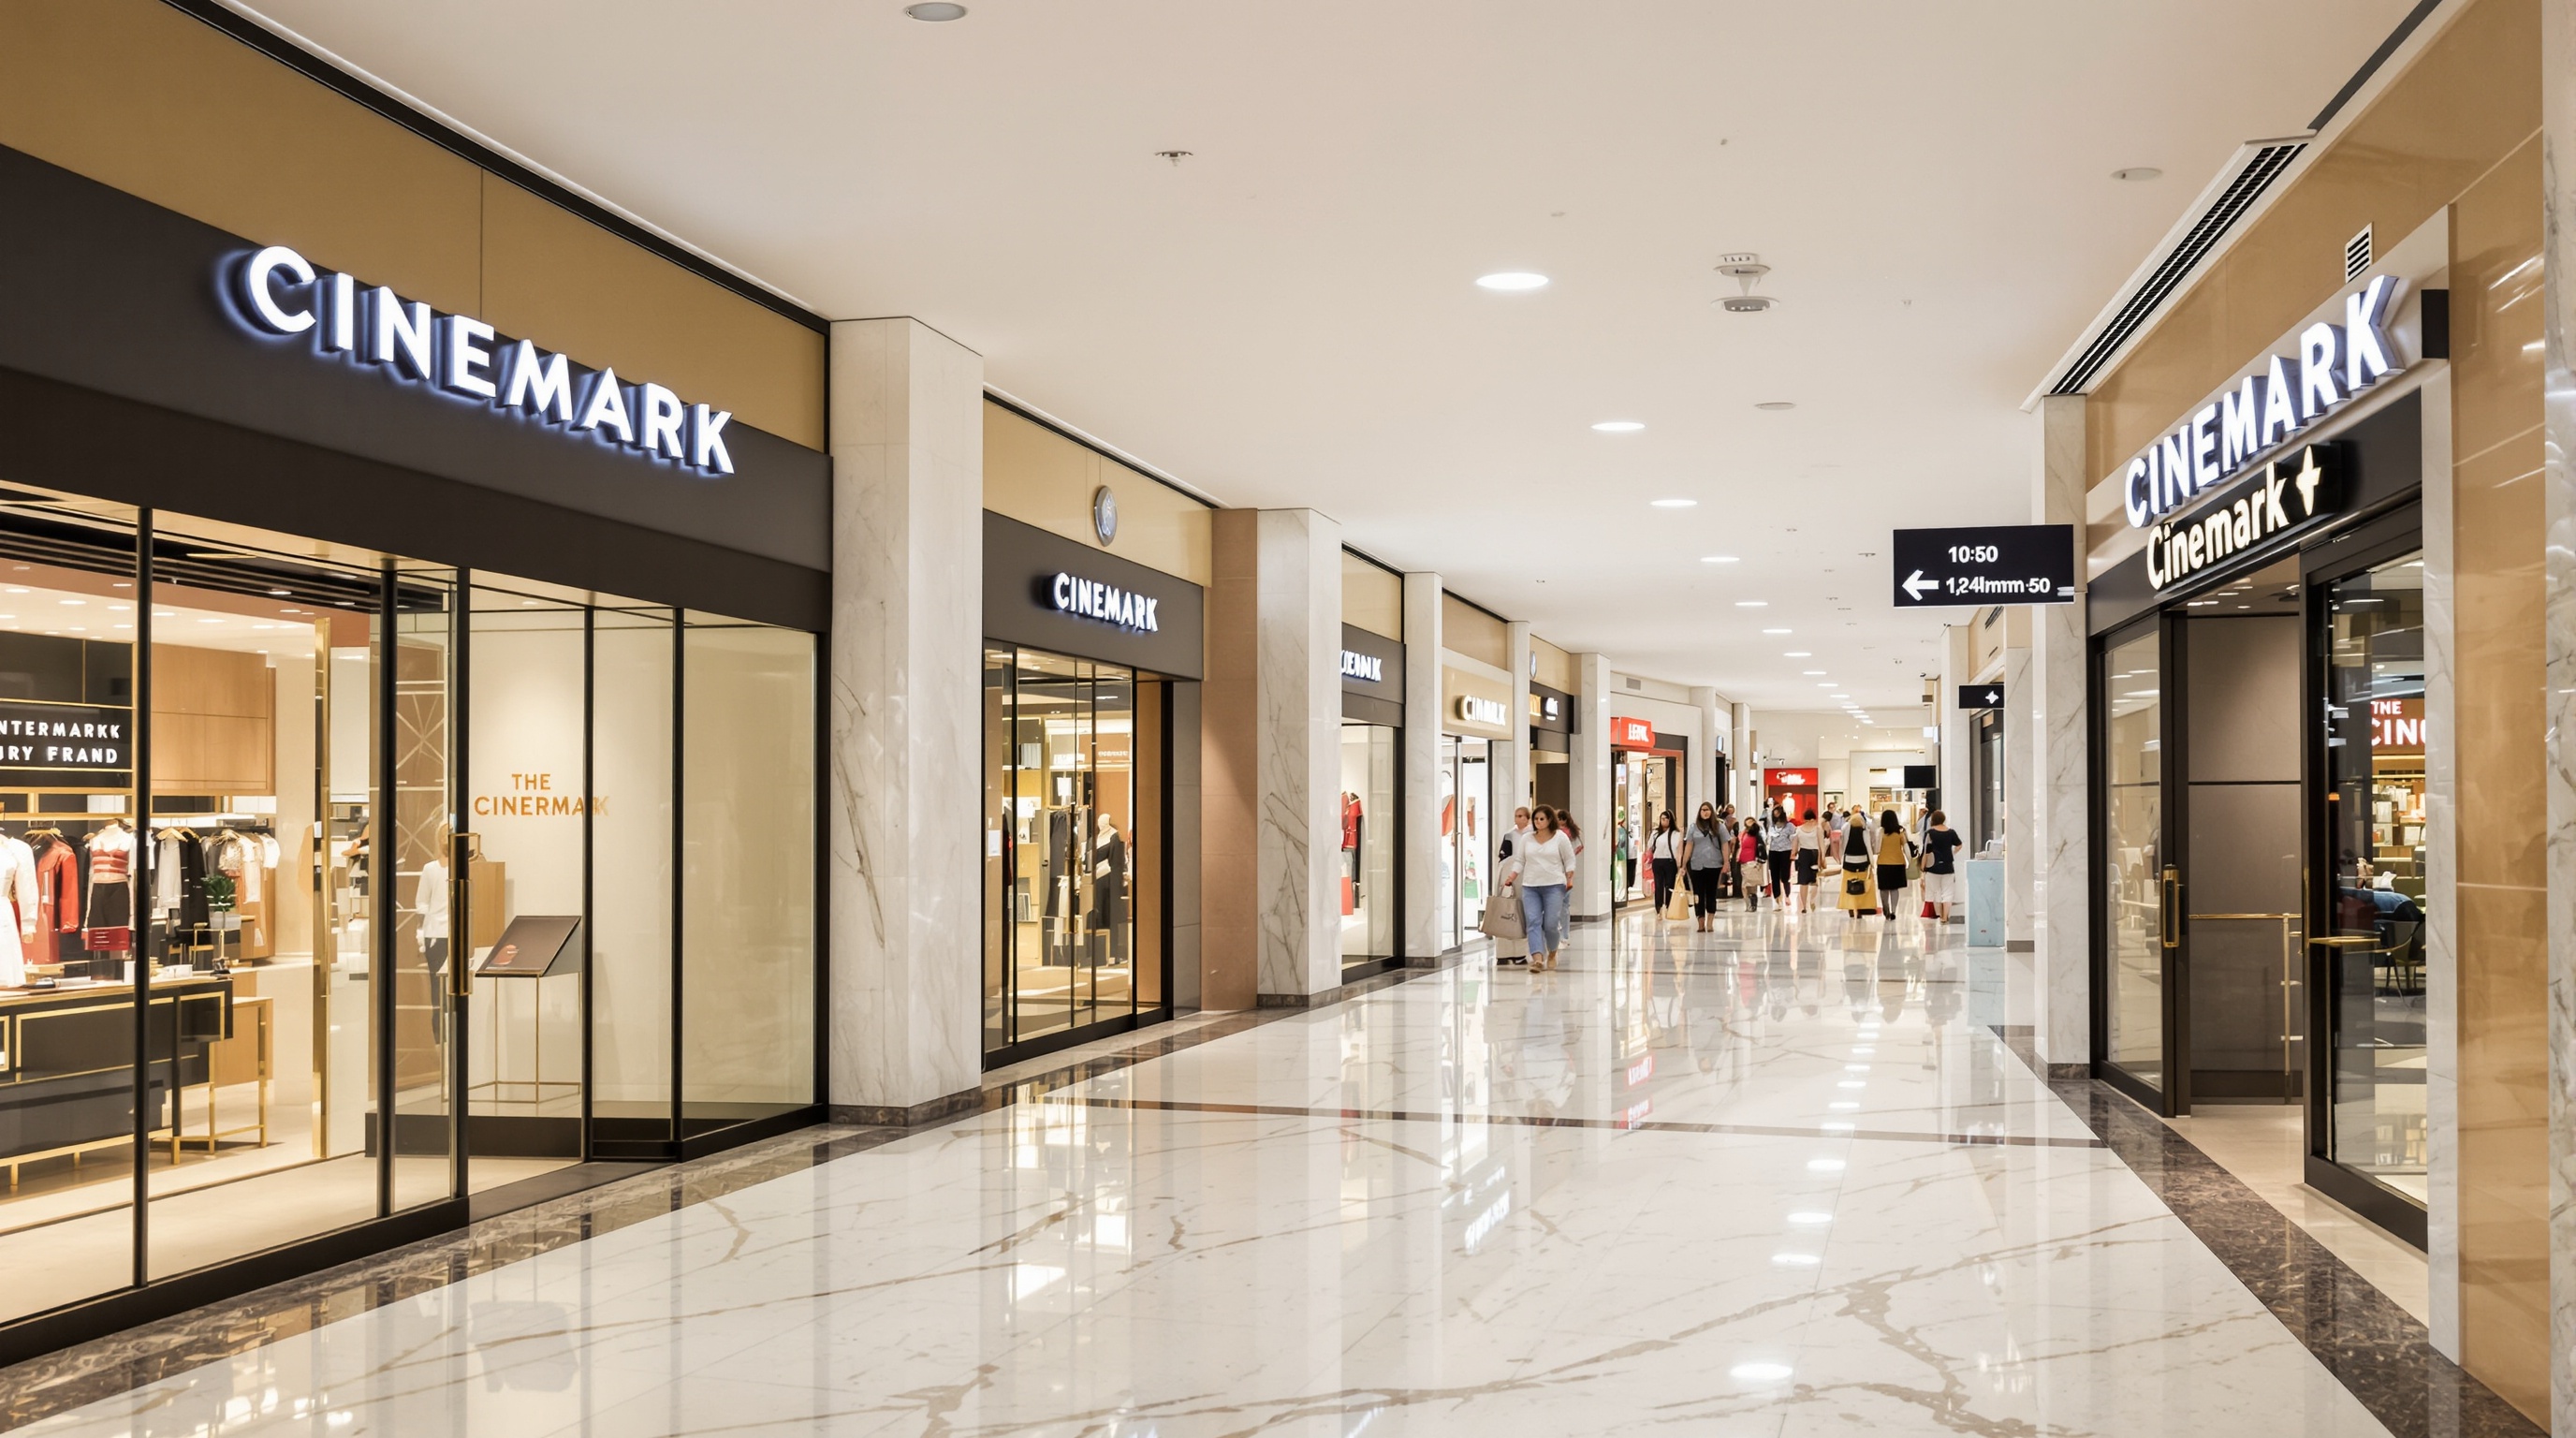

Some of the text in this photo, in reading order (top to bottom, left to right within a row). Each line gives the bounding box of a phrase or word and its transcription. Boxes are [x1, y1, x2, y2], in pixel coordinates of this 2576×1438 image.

[247, 245, 735, 475] CINEMARK
[2125, 274, 2398, 529] CINEMARK
[1948, 545, 1999, 564] 10:50
[2146, 460, 2291, 592] Cinemark
[1053, 572, 1159, 633] CINEMARK
[511, 773, 551, 790] THE
